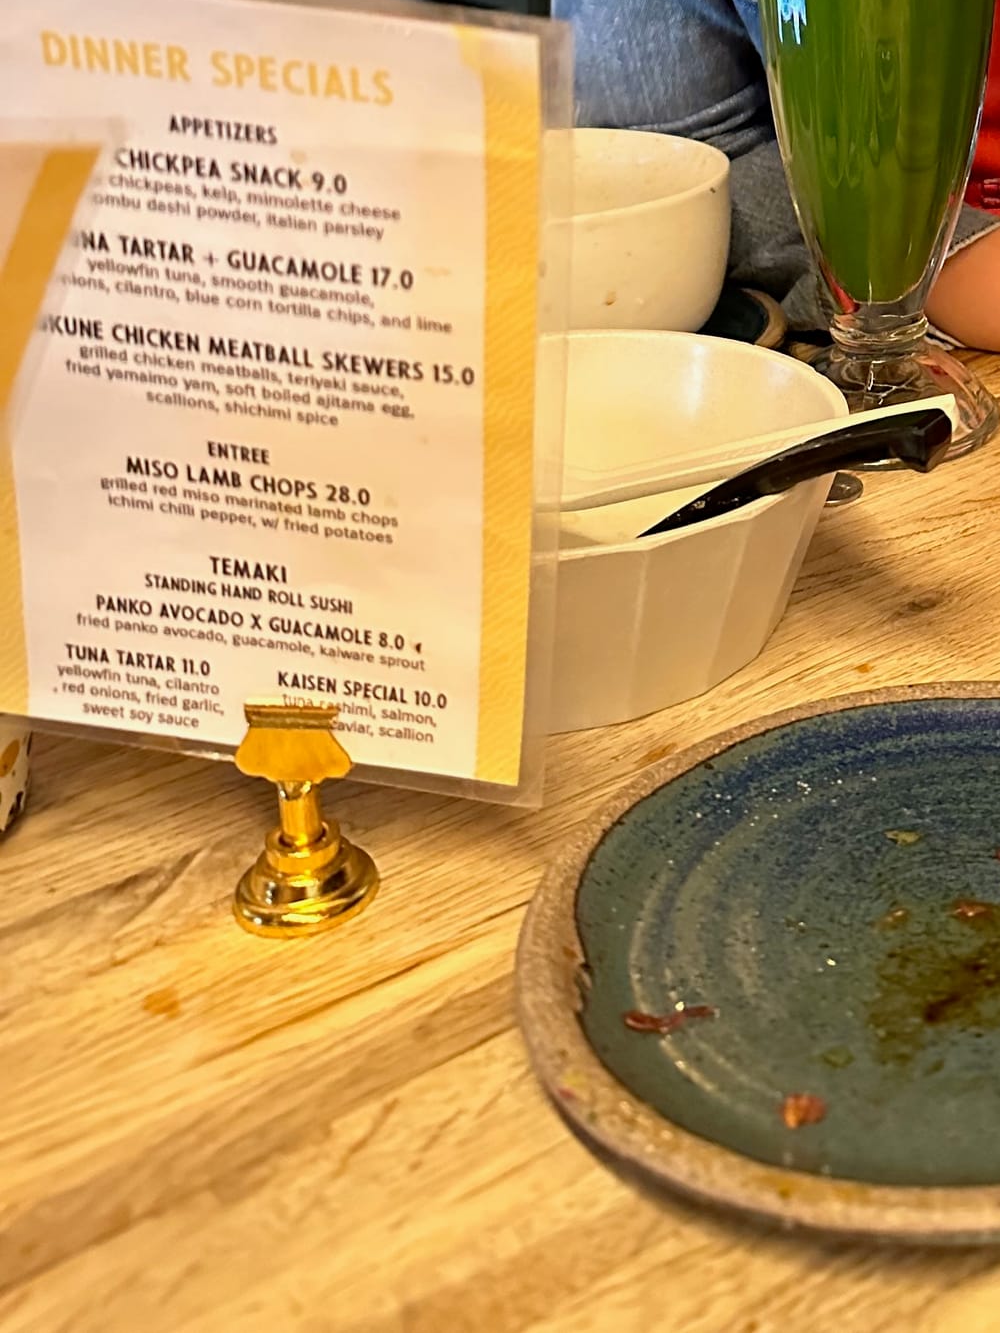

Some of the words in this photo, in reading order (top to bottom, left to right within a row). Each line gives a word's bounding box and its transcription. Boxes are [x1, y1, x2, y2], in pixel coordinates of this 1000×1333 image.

[40, 30, 191, 82] DINNER
[211, 50, 393, 106] SPECIALS
[169, 115, 278, 145] APPETIZERS
[115, 147, 221, 179] CHICKPEA
[231, 162, 301, 189] SNACK
[312, 172, 347, 194] 9.0
[90, 193, 141, 209] ombu
[147, 198, 191, 215] dashi
[197, 205, 261, 227] powder,
[266, 212, 317, 231] italian
[323, 222, 384, 241] parsley
[108, 173, 197, 198] chickpeas,
[202, 185, 241, 204] kelp,
[247, 191, 333, 213] mimolette
[339, 202, 401, 220] cheese
[72, 230, 109, 252] NA
[119, 235, 194, 264] TARTAR
[204, 253, 217, 266] +
[227, 250, 362, 286] GUACAMOLE
[372, 268, 414, 290] 17.0
[88, 258, 159, 279] yellowfin
[165, 269, 206, 288] tuna,
[212, 275, 274, 296] smooth
[279, 285, 375, 309] guacamole,
[60, 275, 110, 293] nions,
[116, 283, 180, 303] cilantro,
[186, 290, 220, 307] blue
[226, 295, 263, 312] corn
[268, 300, 322, 319] tortilla
[327, 307, 376, 327] chips,
[381, 313, 412, 329] and
[416, 316, 453, 334] lime
[39, 315, 104, 340] KUNE
[112, 324, 201, 353] CHICKEN
[209, 337, 313, 368] MEATBALL
[322, 352, 424, 381] SKEWERS
[433, 364, 475, 386] 15.0
[79, 346, 129, 362] grilled
[133, 351, 196, 370] chicken
[201, 359, 282, 383] meatballs,
[287, 373, 347, 392] teriyaki
[352, 383, 405, 400] sauce,
[66, 360, 102, 376] fried
[106, 368, 178, 389] yamaimo
[182, 377, 220, 395] yam,
[225, 383, 256, 399] soft
[261, 387, 311, 405] boiled
[316, 395, 375, 413] ajitama
[146, 391, 220, 413] scallions,
[224, 399, 292, 421] shichimi
[297, 409, 339, 428] spice
[207, 440, 270, 465] ENTREE
[101, 476, 148, 493] grilled
[153, 482, 178, 497] red
[183, 488, 220, 503] miso
[225, 494, 303, 516] marinated
[308, 504, 346, 521] lamb
[351, 511, 399, 528] chops
[126, 455, 179, 480] MISO
[187, 463, 242, 488] LAMB
[249, 473, 318, 500] CHOPS
[325, 483, 371, 507] 28.0
[159, 500, 195, 517] chilli
[201, 508, 257, 529] pepper,
[261, 516, 280, 530] w/
[284, 518, 319, 534] fried
[324, 526, 394, 545] potatoes
[210, 556, 288, 584] TEMAKI
[145, 573, 217, 596] STANDING
[221, 583, 263, 601] HAND
[268, 589, 305, 608] ROLL
[310, 595, 353, 615] SUSHI
[77, 613, 110, 629] fried
[115, 620, 159, 635] panko
[163, 626, 228, 646] avocado,
[232, 633, 315, 657] guacamole,
[320, 644, 375, 664] kaiware
[379, 655, 426, 672] sprout
[96, 594, 153, 617] PANKO
[160, 602, 244, 629] AVOCADO
[250, 613, 263, 630] X
[269, 616, 373, 646] GUACAMOLE
[378, 632, 405, 651] 8.0
[57, 664, 122, 682] yellowfin
[125, 671, 161, 690] tuna,
[165, 678, 220, 696] cilantro
[65, 643, 110, 664] TUNA
[116, 650, 176, 673] TARTAR
[182, 658, 211, 677] 11.0
[62, 681, 85, 695] red
[90, 686, 141, 704] onions,
[145, 692, 178, 708] fried
[182, 699, 225, 716] garlic,
[278, 671, 338, 695] KAISEN
[343, 680, 408, 705] SPECIAL
[414, 691, 448, 710] 10.0
[83, 702, 124, 719] sweet
[130, 710, 154, 725] soy
[158, 715, 199, 729] sauce
[379, 726, 434, 744] scallion
[381, 709, 437, 729] salmon,
